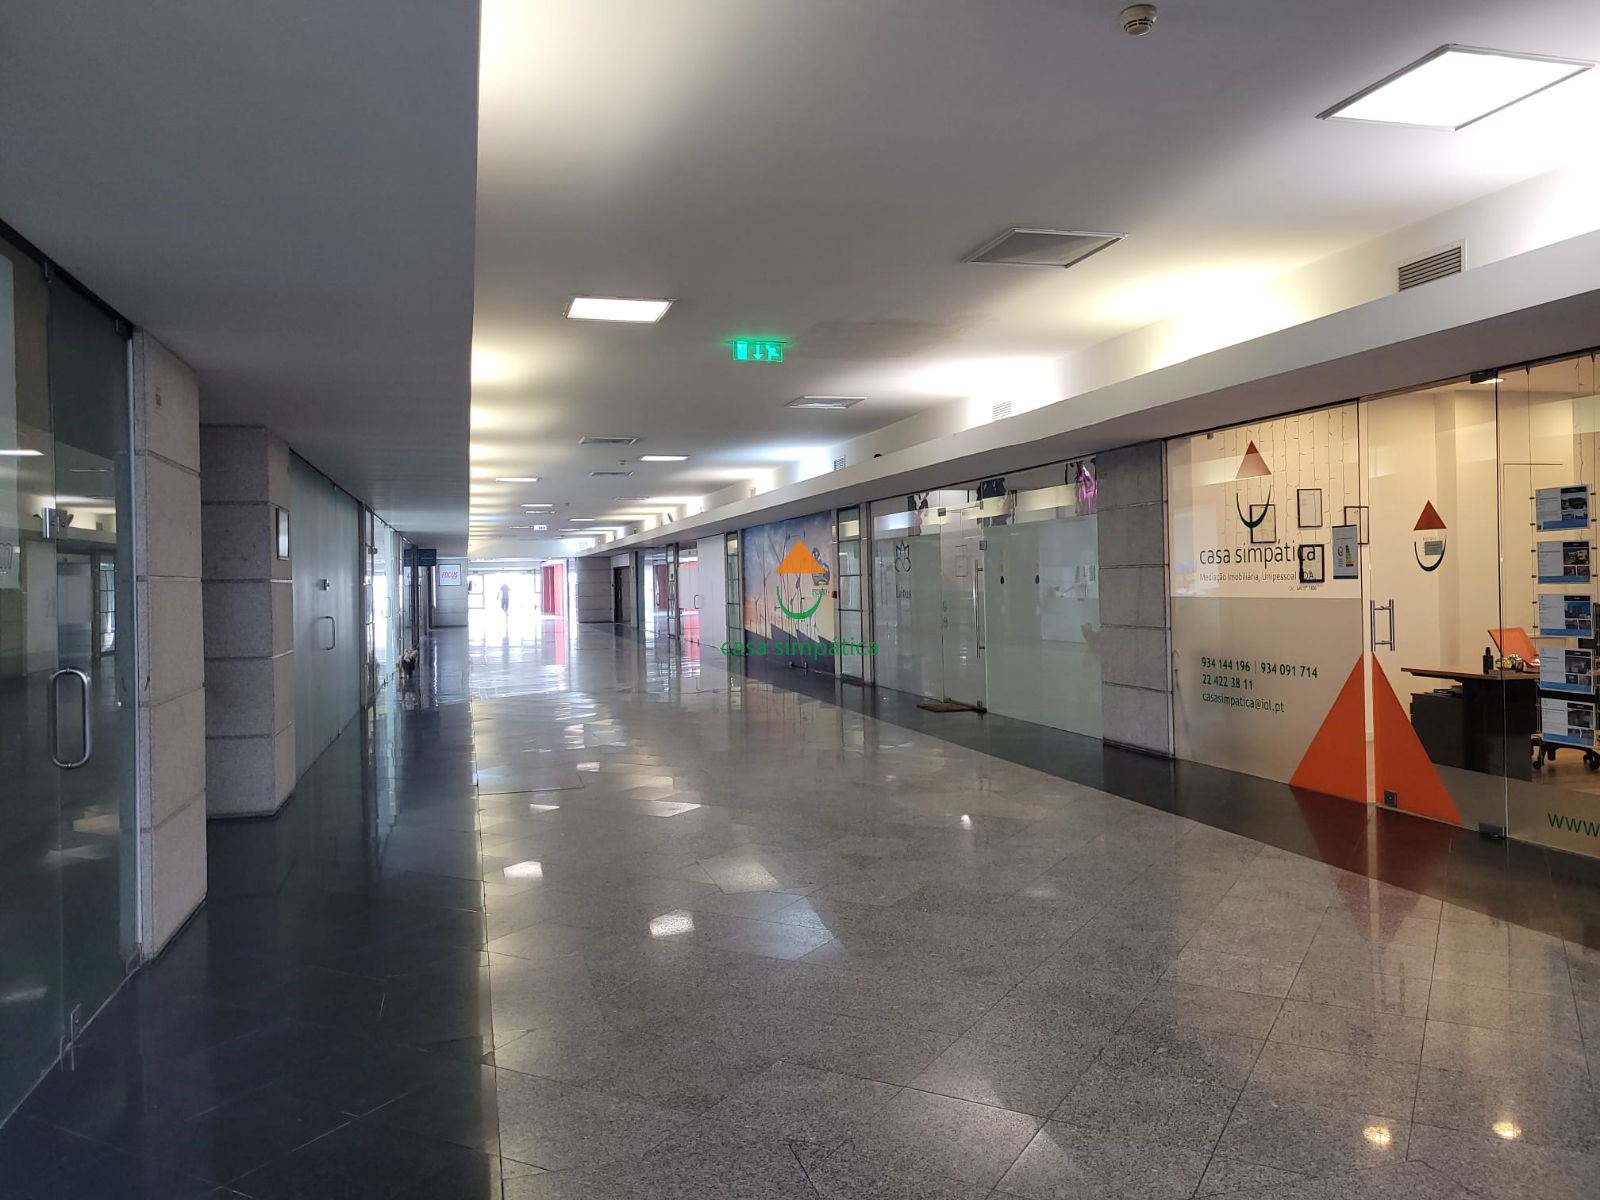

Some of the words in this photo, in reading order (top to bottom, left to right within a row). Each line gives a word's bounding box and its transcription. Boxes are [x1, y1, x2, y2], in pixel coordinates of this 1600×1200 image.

[1199, 547, 1231, 565] casa
[1235, 539, 1316, 569] simpática
[1201, 657, 1216, 668] 934
[1219, 659, 1233, 670] 144
[1236, 660, 1251, 672] 196
[1260, 662, 1277, 674] 934
[1279, 664, 1296, 676] 091
[1300, 665, 1318, 678] 714
[1202, 674, 1212, 685] 22
[1214, 676, 1229, 687] 422
[1231, 677, 1241, 688] 38
[1244, 679, 1253, 690] 11
[1202, 692, 1285, 714] casasimpatica@iol.pt
